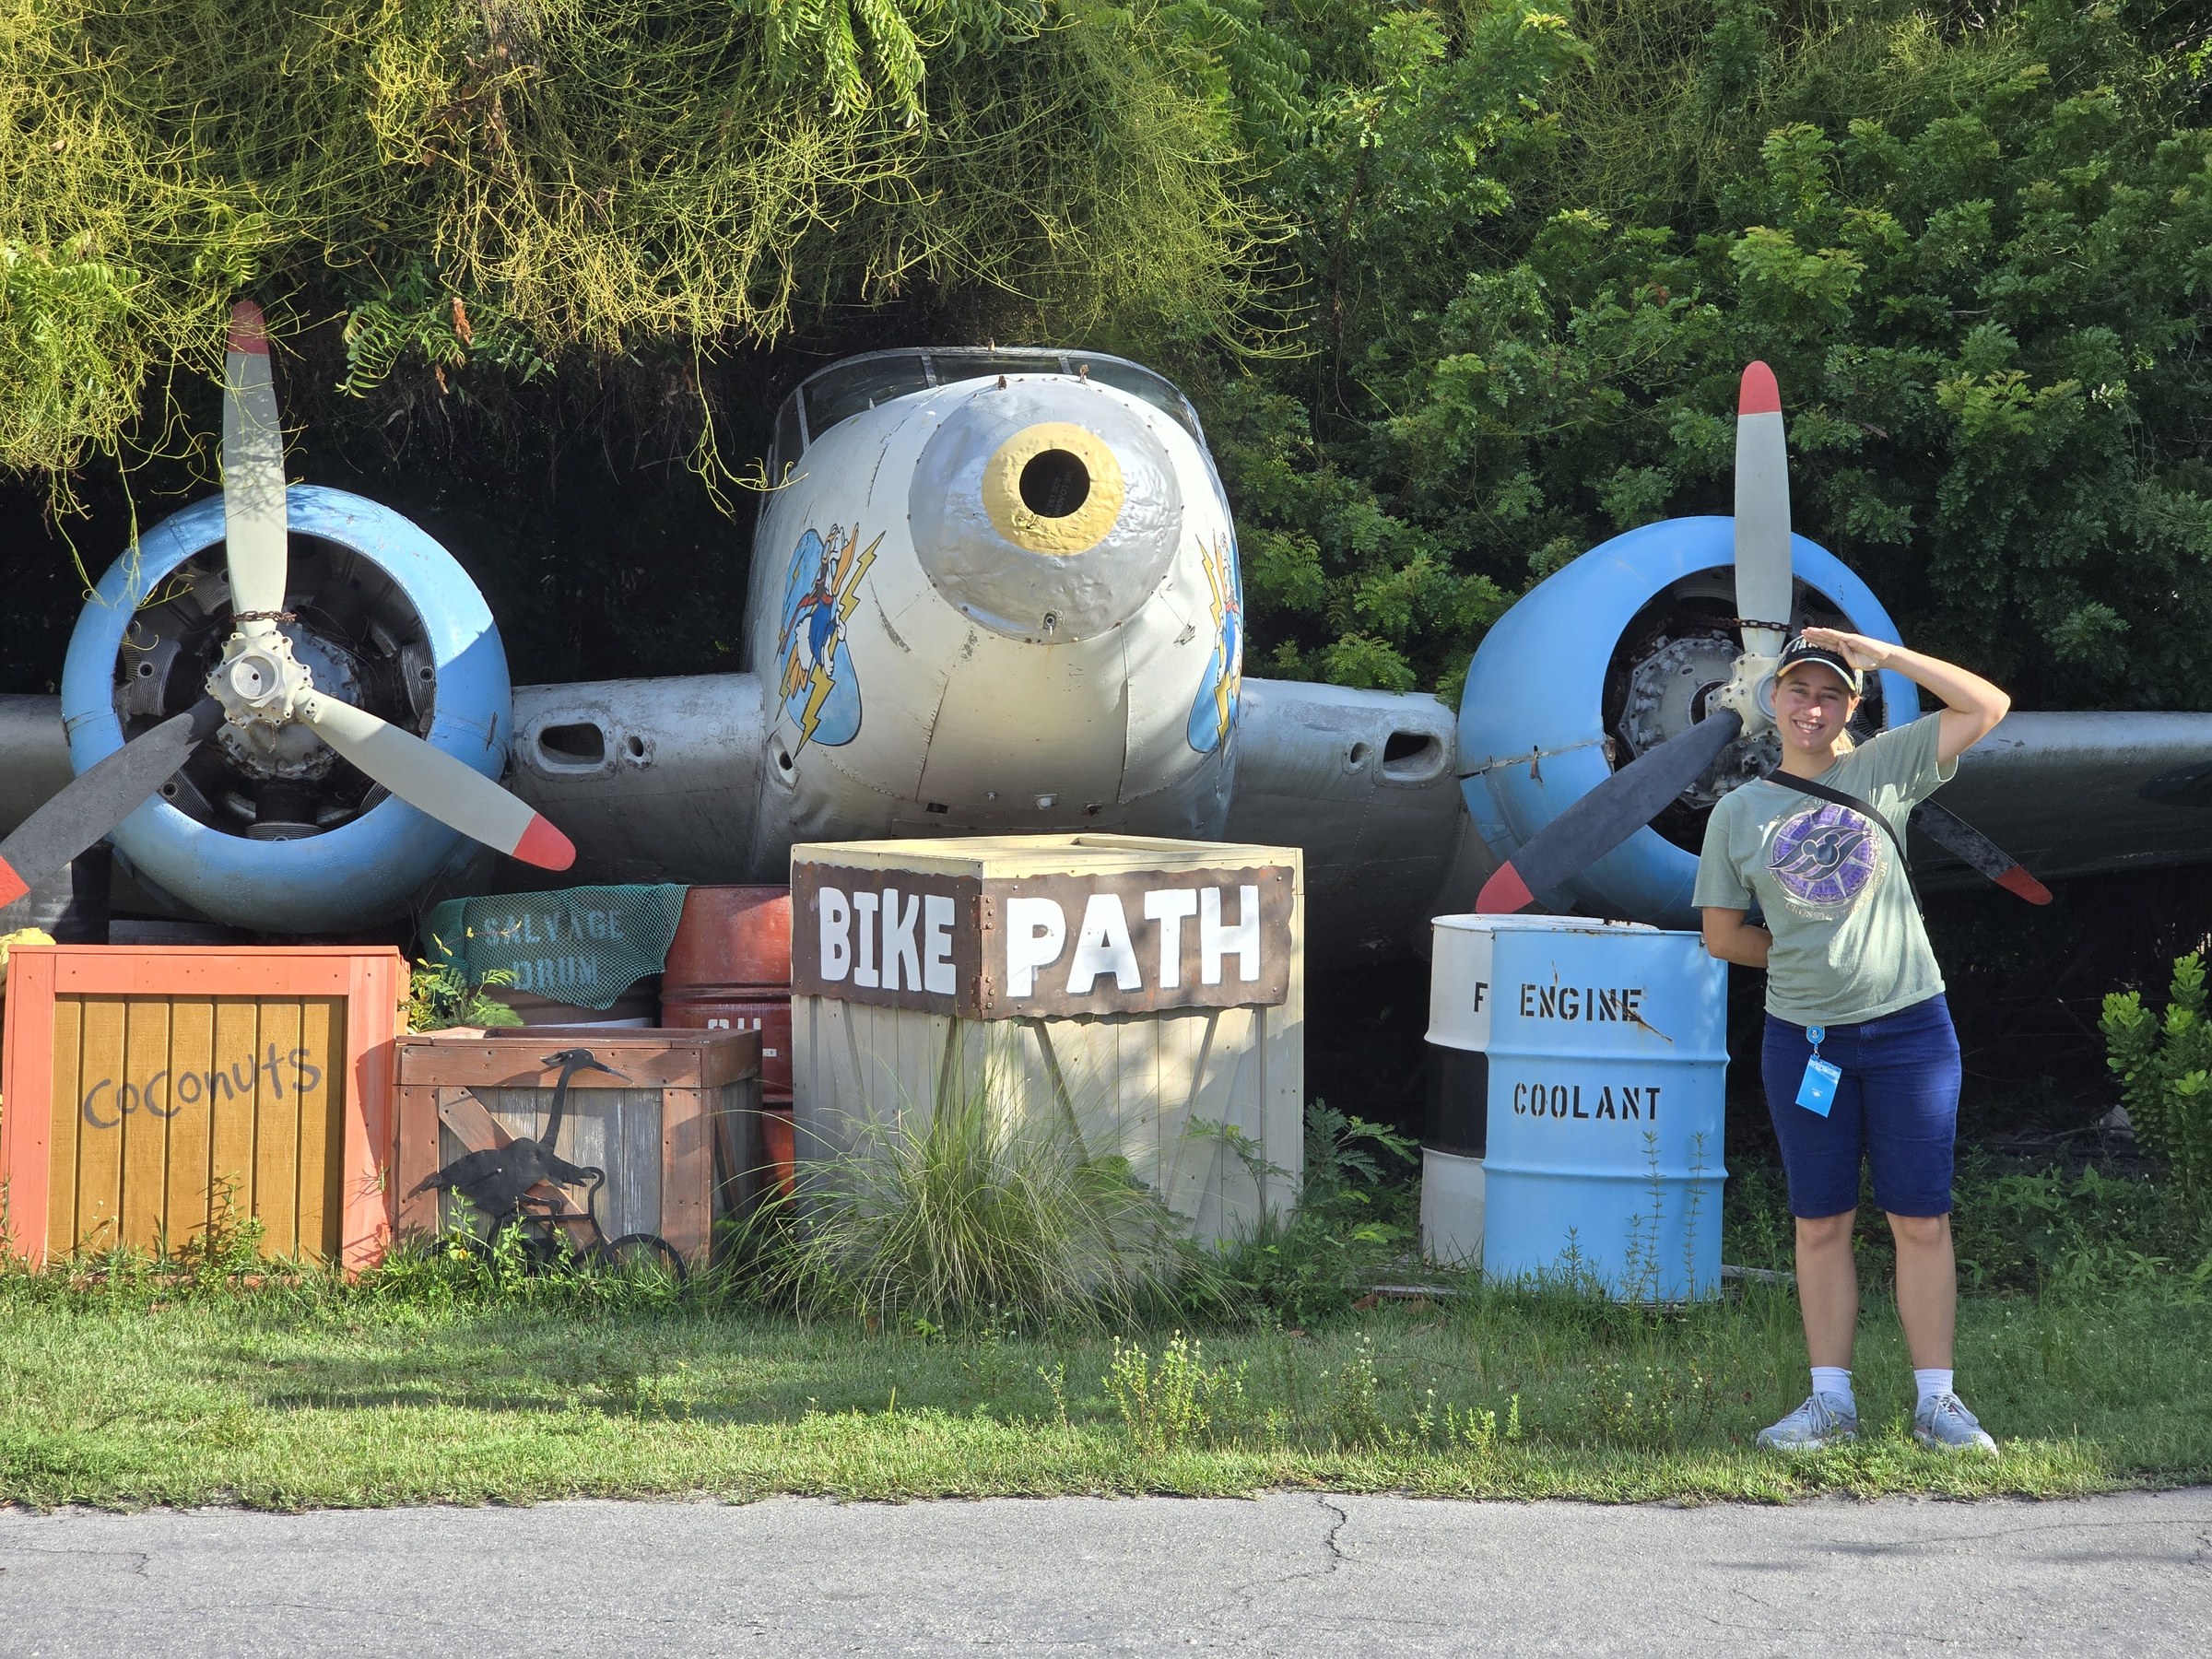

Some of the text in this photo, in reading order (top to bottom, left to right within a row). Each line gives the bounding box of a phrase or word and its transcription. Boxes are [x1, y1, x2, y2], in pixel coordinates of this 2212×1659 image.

[483, 910, 625, 947] SALVAGE
[818, 884, 1262, 998] BIKE PATH
[512, 956, 599, 990] DRUM
[1520, 982, 1644, 1023] ENGINE
[1512, 1081, 1661, 1121] COOLANT
